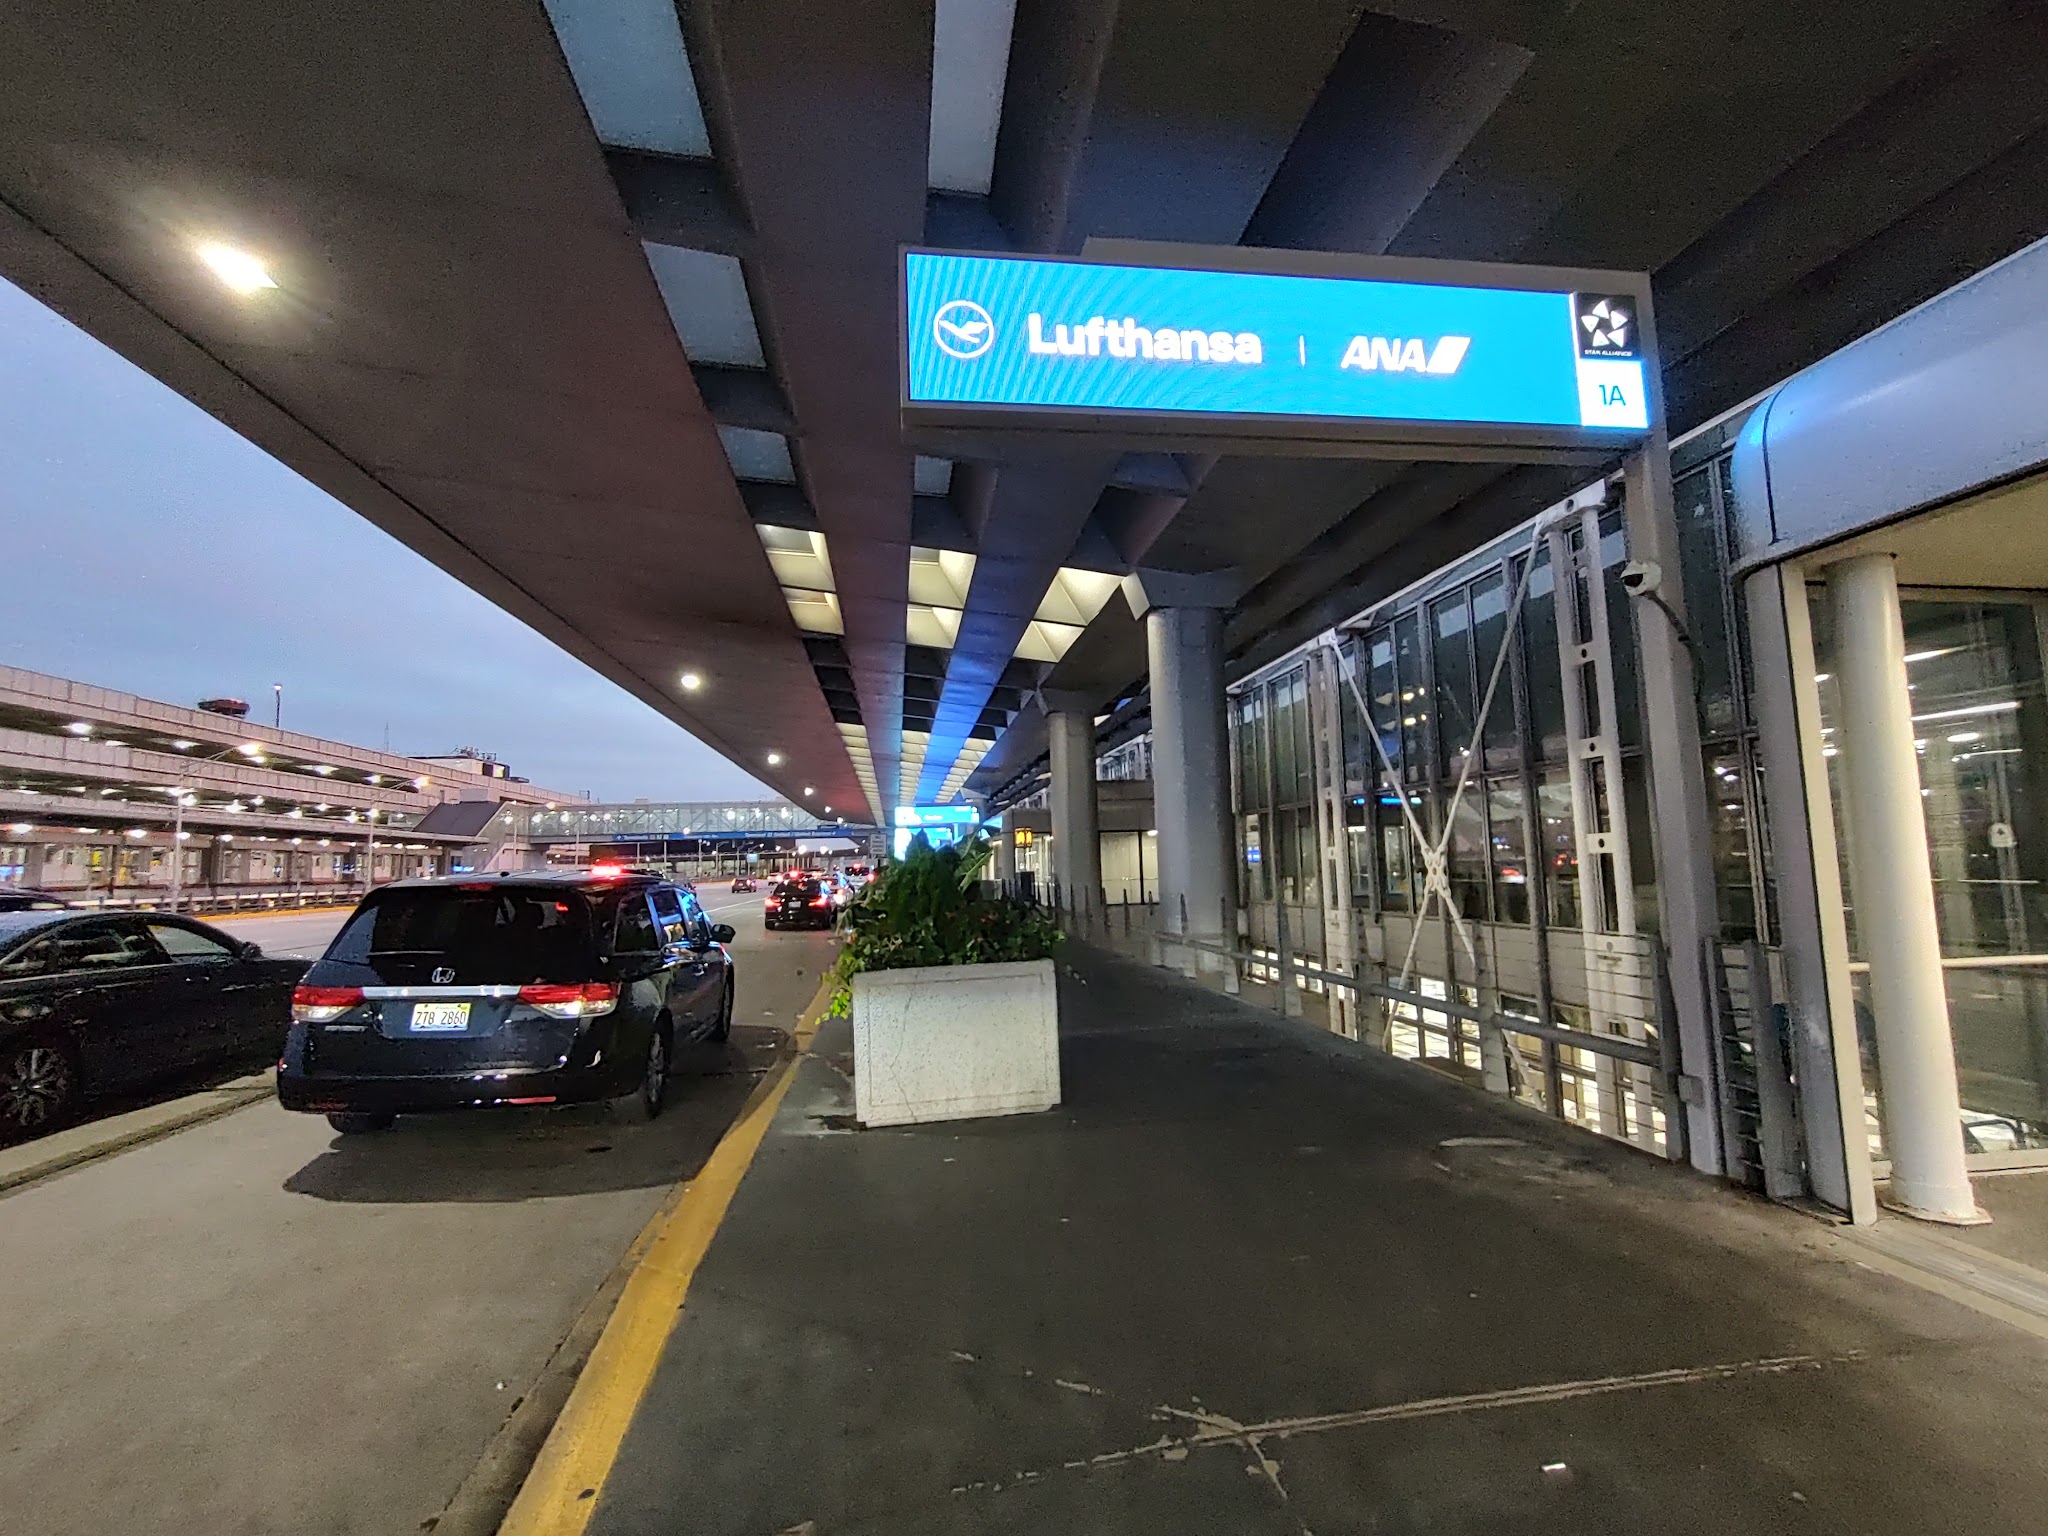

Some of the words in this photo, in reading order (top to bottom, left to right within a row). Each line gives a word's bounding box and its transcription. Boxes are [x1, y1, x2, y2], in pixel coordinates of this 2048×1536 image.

[1028, 312, 1262, 363] Lufthansa
[1340, 335, 1427, 373] ANA
[1598, 384, 1626, 406] 1A
[440, 1011, 467, 1025] 2860
